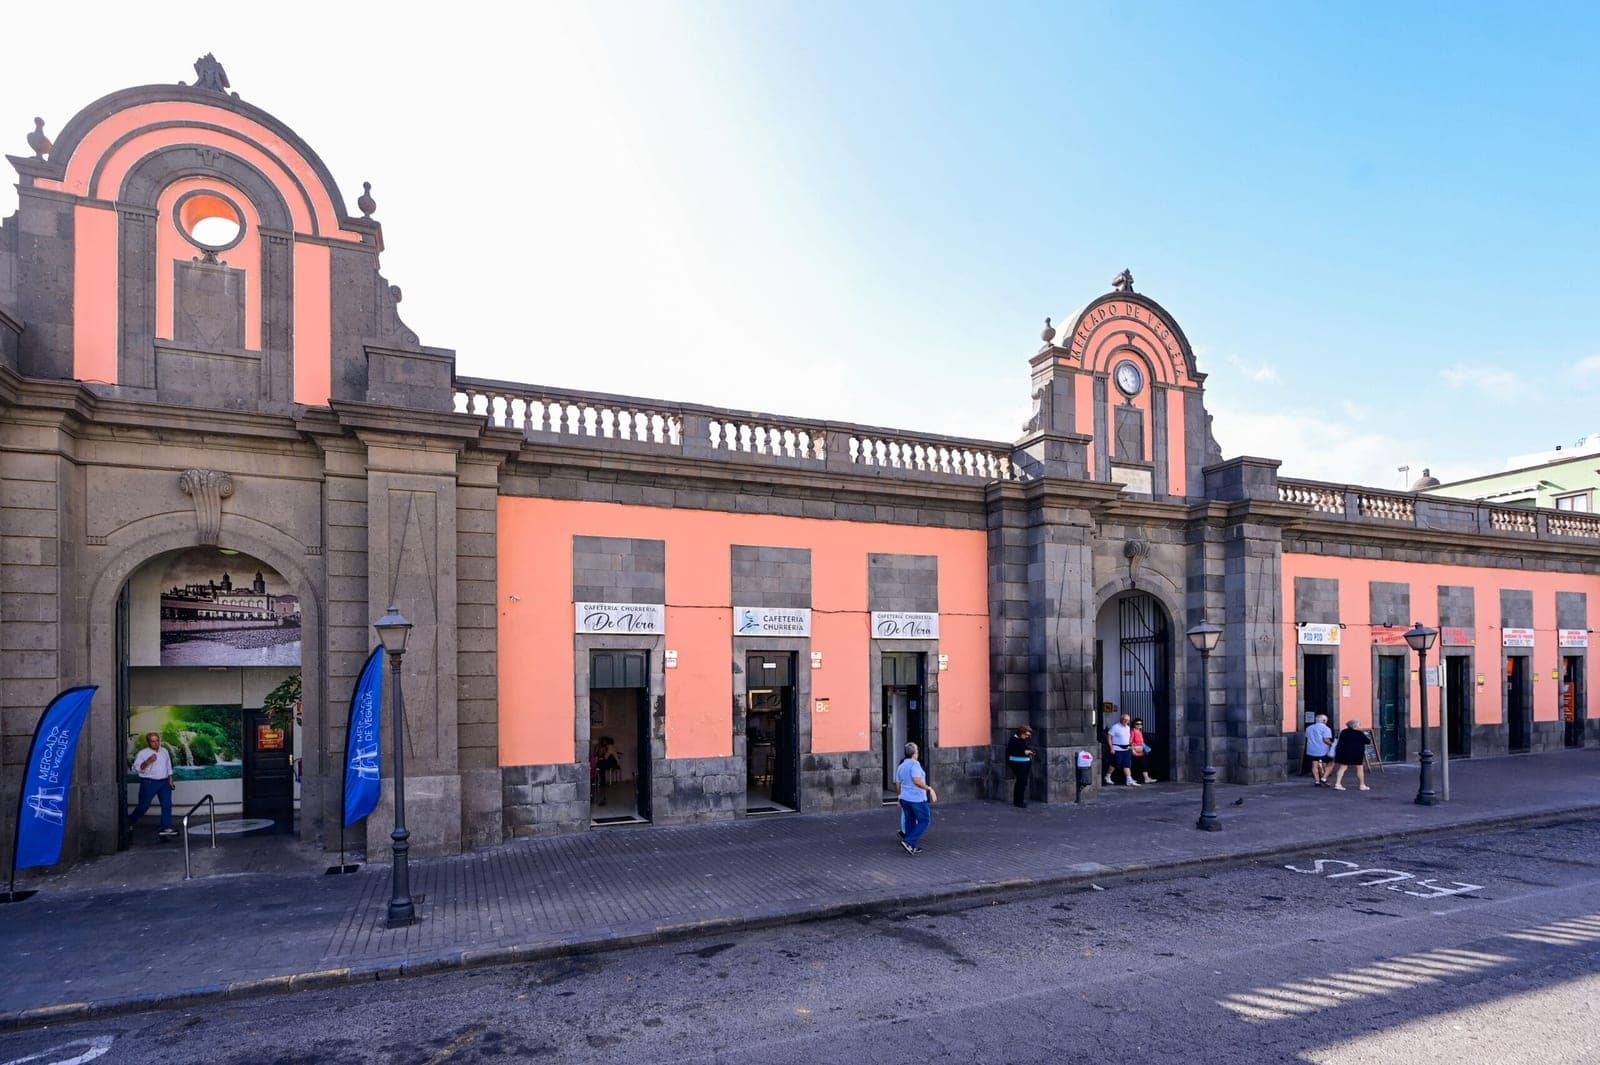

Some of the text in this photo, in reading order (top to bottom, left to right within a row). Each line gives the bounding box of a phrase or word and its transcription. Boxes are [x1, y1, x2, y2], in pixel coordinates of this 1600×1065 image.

[1071, 303, 1185, 376] MERCADO DE VEGUETA
[583, 604, 657, 613] CAFETERIA CHURRERIA
[584, 612, 656, 632] De Vera
[763, 615, 804, 623] CAFETERIA
[763, 623, 804, 631] CHURRERIA
[877, 620, 931, 637] De Vera
[364, 689, 373, 742] DE VEGUETA
[38, 725, 60, 780] MERCADO
[48, 729, 71, 784] DE VEGUETA
